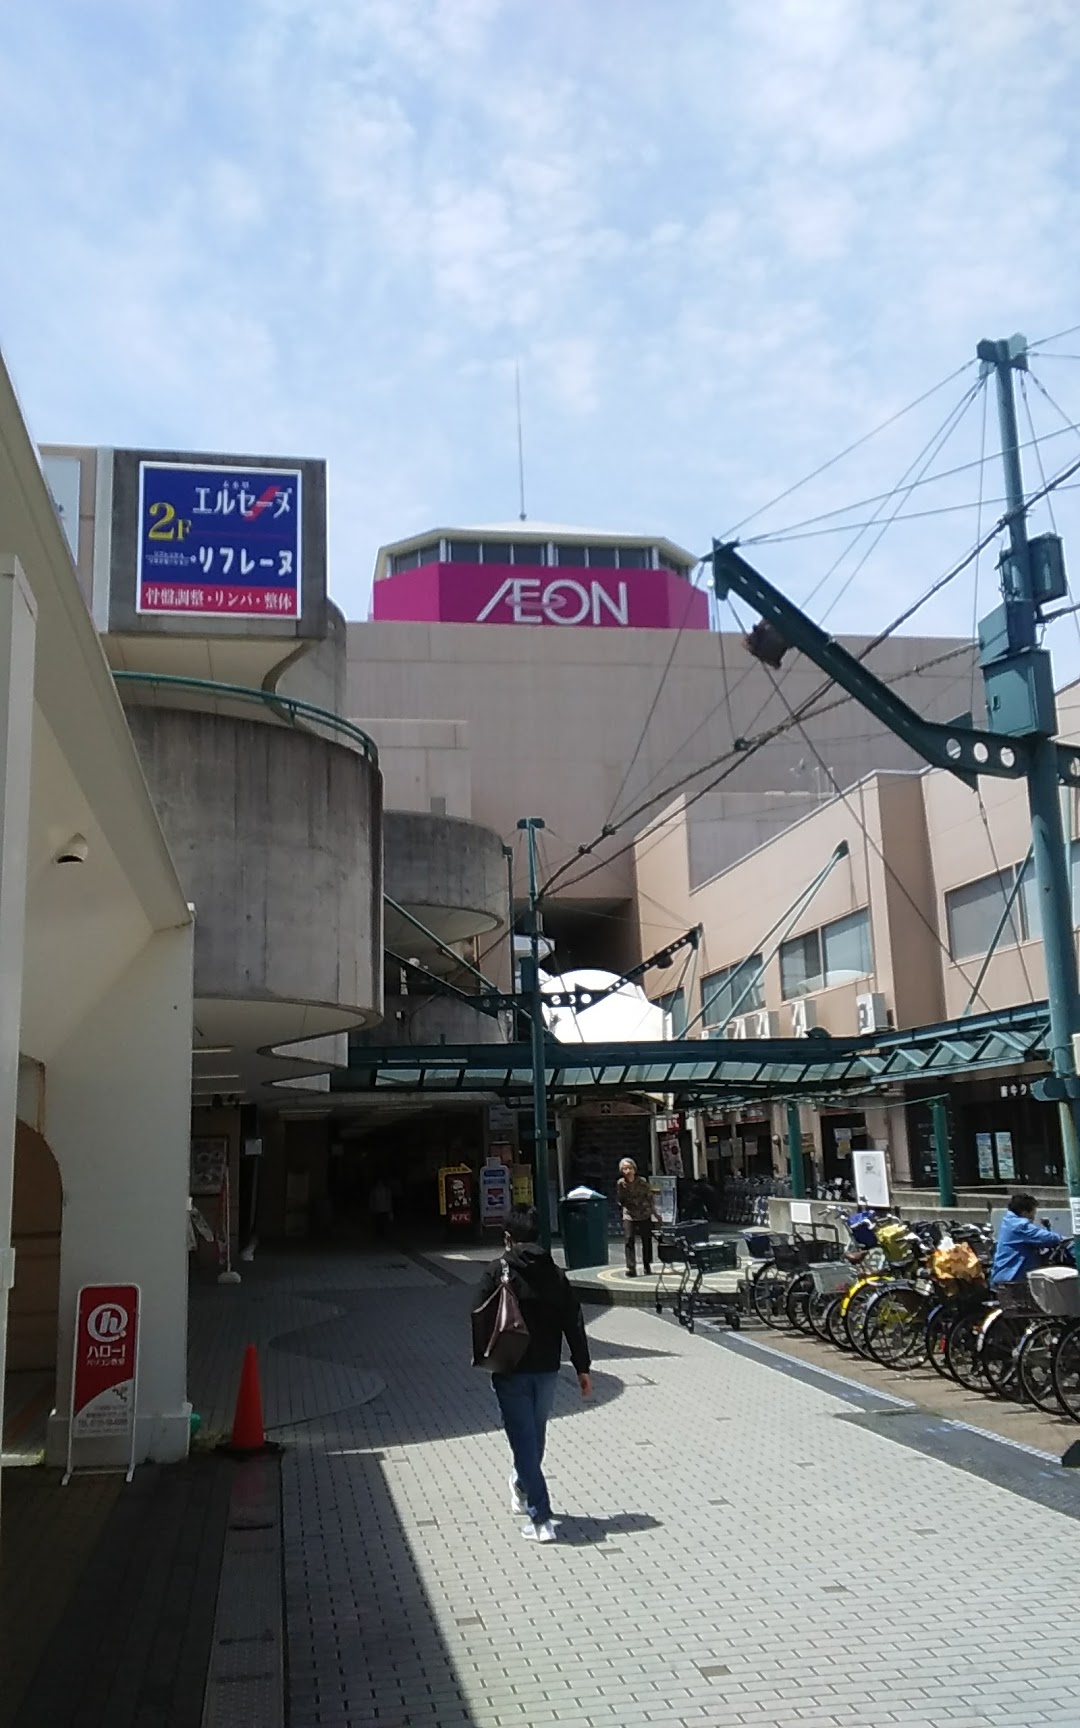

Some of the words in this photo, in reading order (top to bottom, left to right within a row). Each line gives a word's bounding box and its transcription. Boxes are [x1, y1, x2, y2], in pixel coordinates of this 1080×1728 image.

[148, 502, 192, 540] 2F
[199, 546, 293, 577] リフレーヌ
